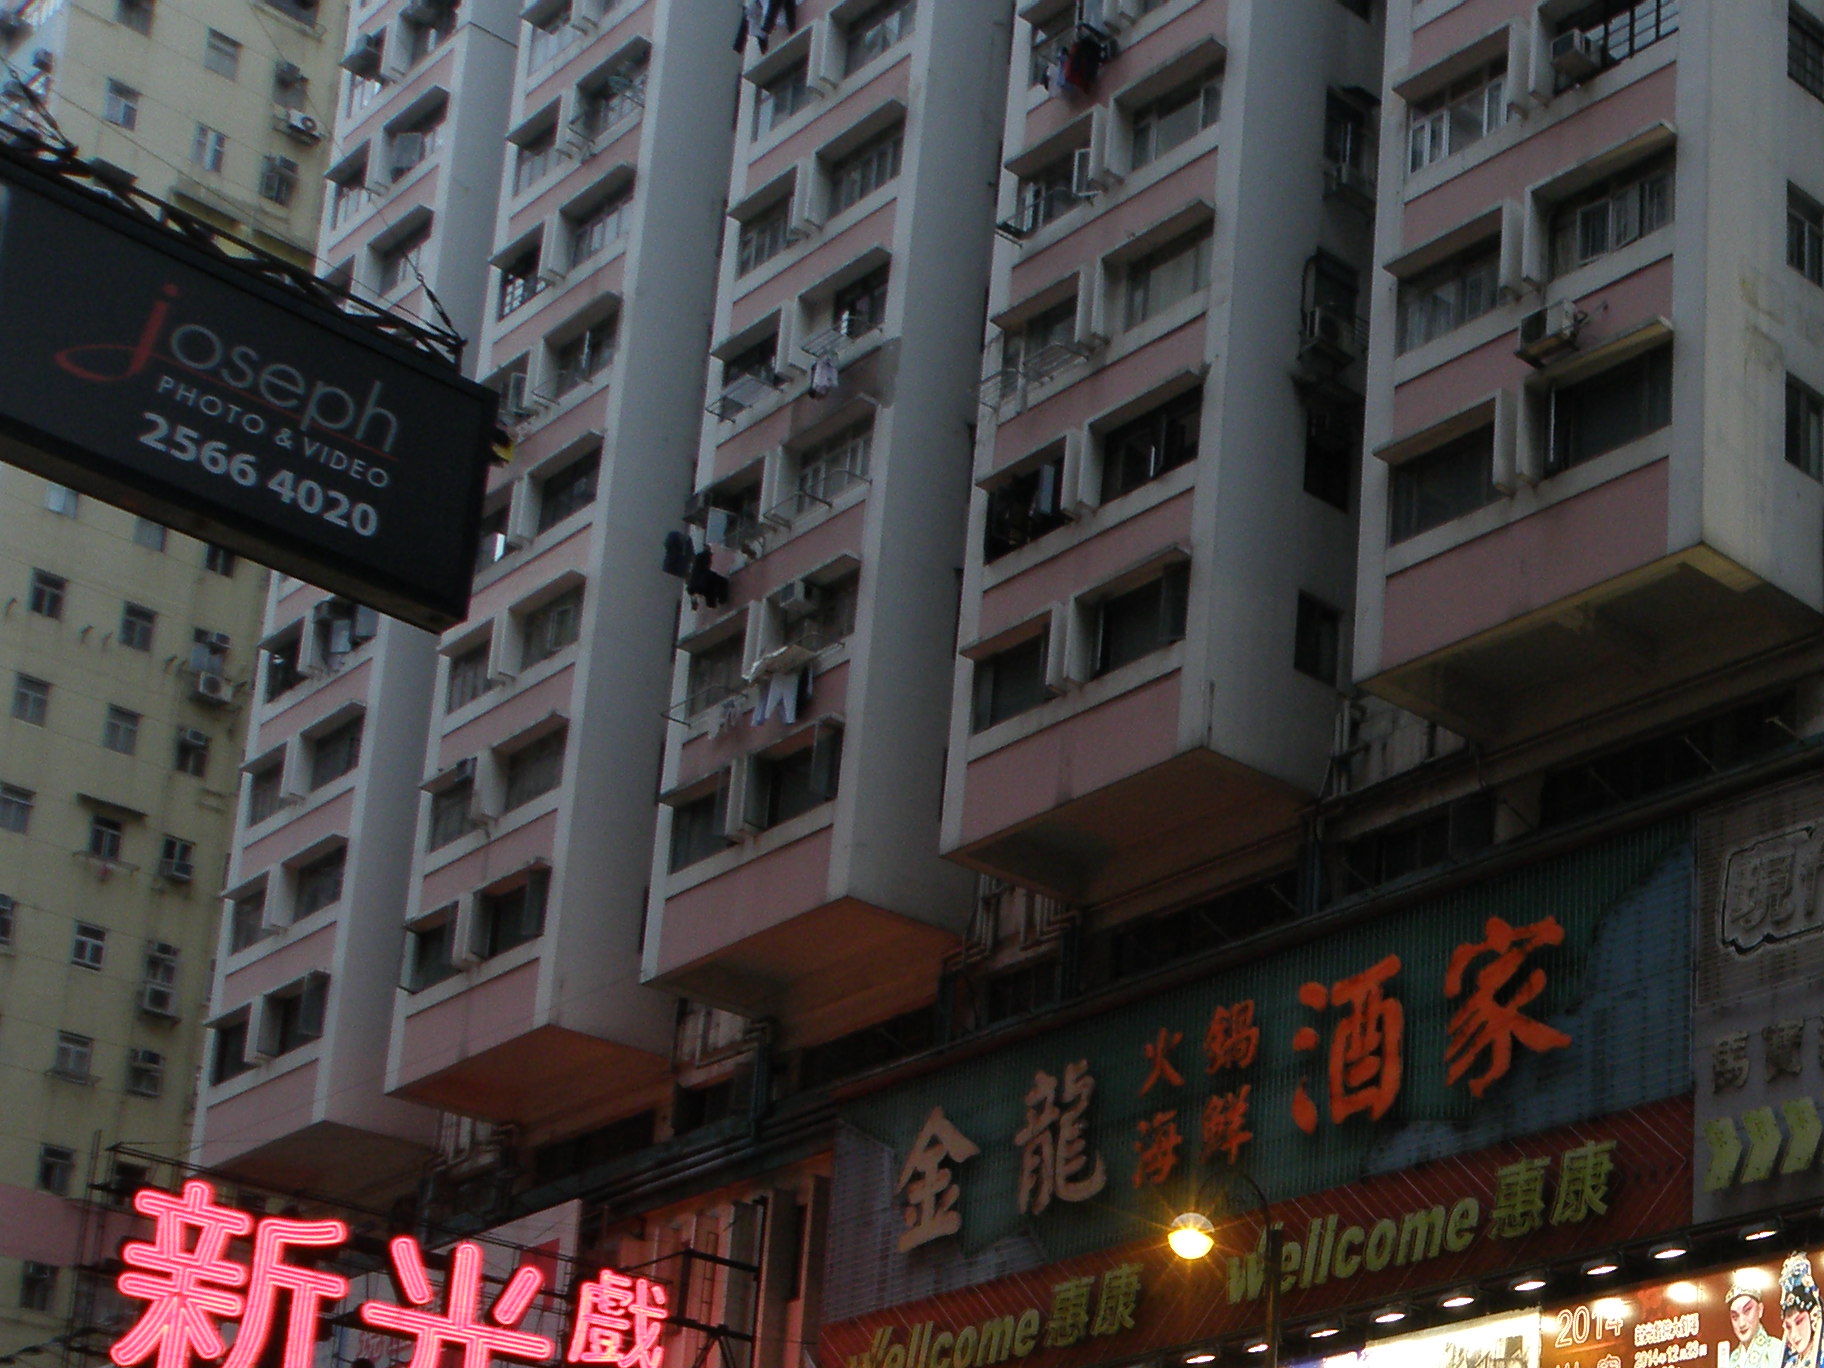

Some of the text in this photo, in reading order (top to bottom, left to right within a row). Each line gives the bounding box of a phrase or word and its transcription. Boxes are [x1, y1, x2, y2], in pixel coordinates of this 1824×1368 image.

[139, 412, 379, 537] 2566 4020
[158, 375, 390, 489] PHOTO & VIDEO
[1139, 999, 1259, 1098] 火鍋
[1292, 914, 1573, 1136] 酒家
[893, 1059, 1110, 1255] 金龍
[1134, 1085, 1254, 1190] 海鮮
[1489, 1138, 1618, 1241] 惠康
[1226, 1198, 1479, 1304] Wellcome
[1046, 1261, 1145, 1348] 惠康
[1555, 1305, 1623, 1347] 2014
